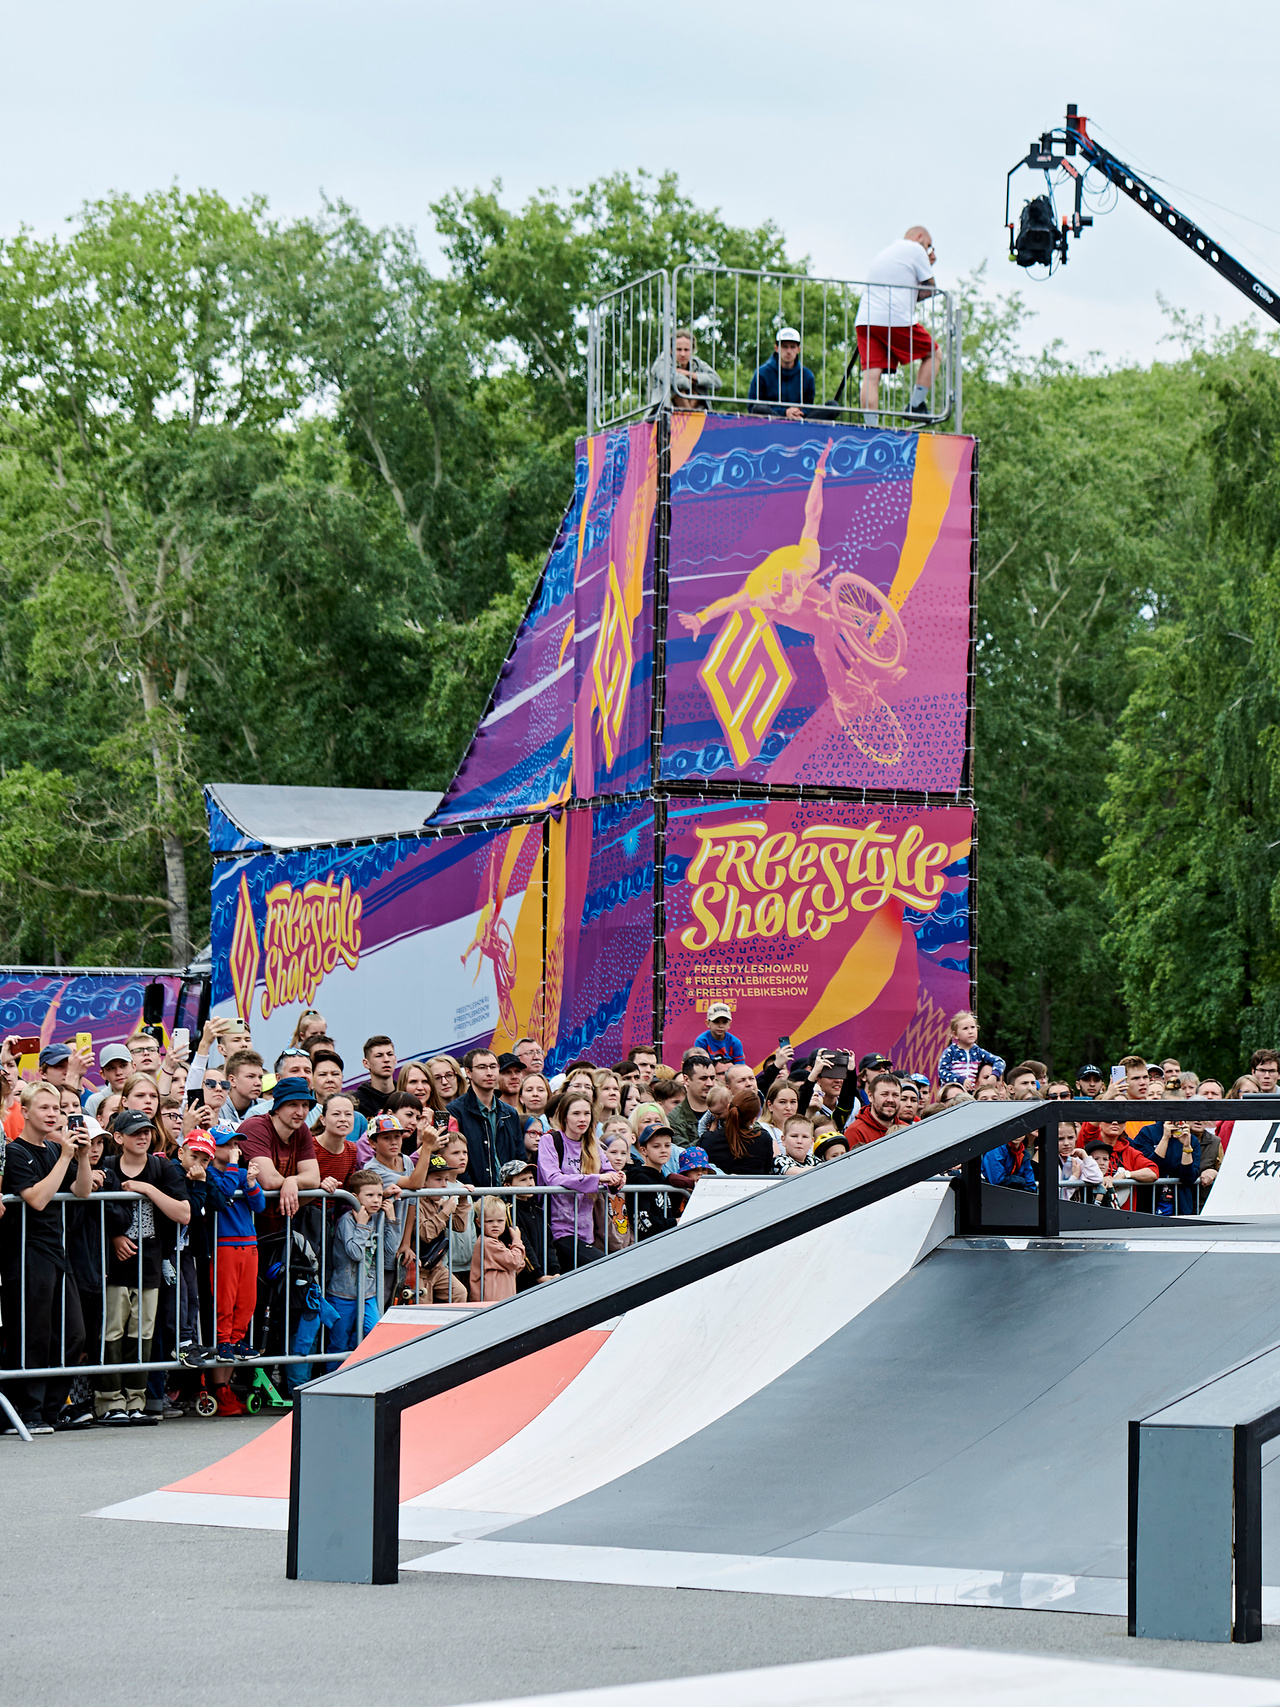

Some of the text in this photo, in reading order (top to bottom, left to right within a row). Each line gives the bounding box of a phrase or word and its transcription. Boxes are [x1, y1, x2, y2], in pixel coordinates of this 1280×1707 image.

[681, 881, 849, 951] Show
[694, 963, 810, 974] FREESTYLESHOW.RU
[261, 945, 323, 1018] Show
[694, 975, 809, 986] FREESTYLEBIKESHOW
[686, 987, 809, 998] @FREESTYLEBIKESHOW
